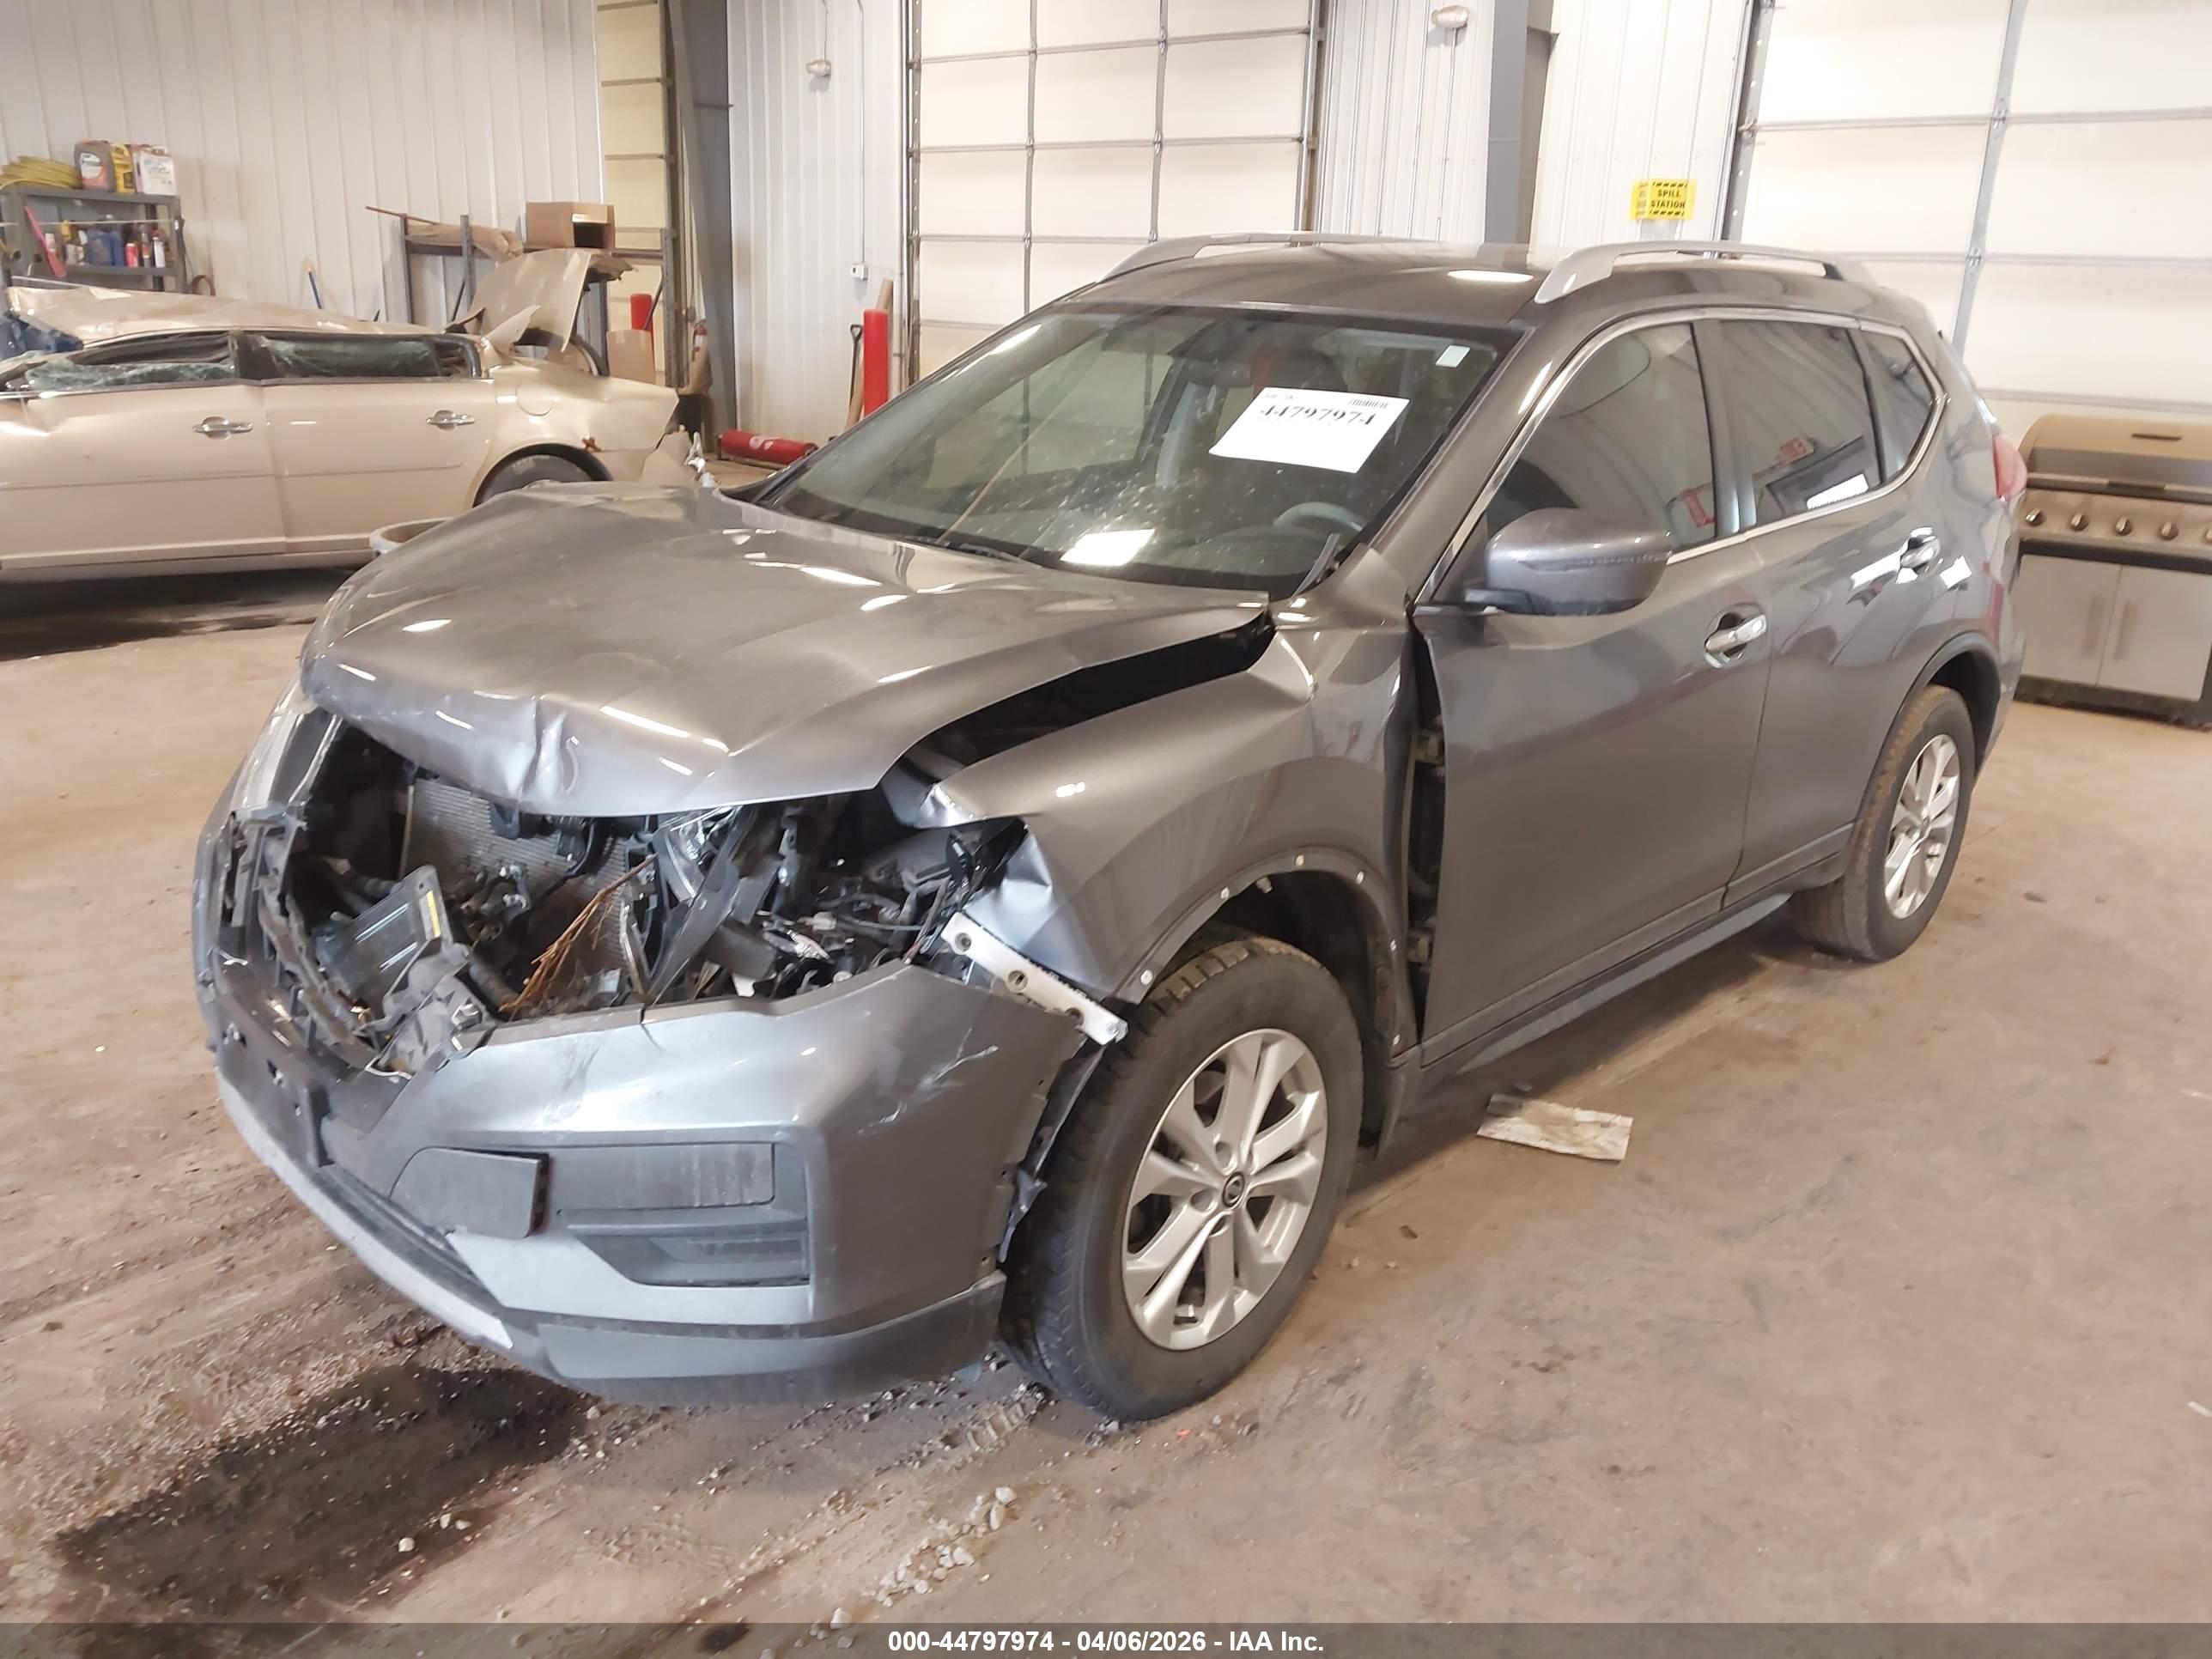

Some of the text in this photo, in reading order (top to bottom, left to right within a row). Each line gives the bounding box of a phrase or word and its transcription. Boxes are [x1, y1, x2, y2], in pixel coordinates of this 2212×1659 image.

[1657, 189, 1681, 198] SPILL
[1650, 200, 1686, 209] STATION
[1261, 404, 1376, 425] 44797974
